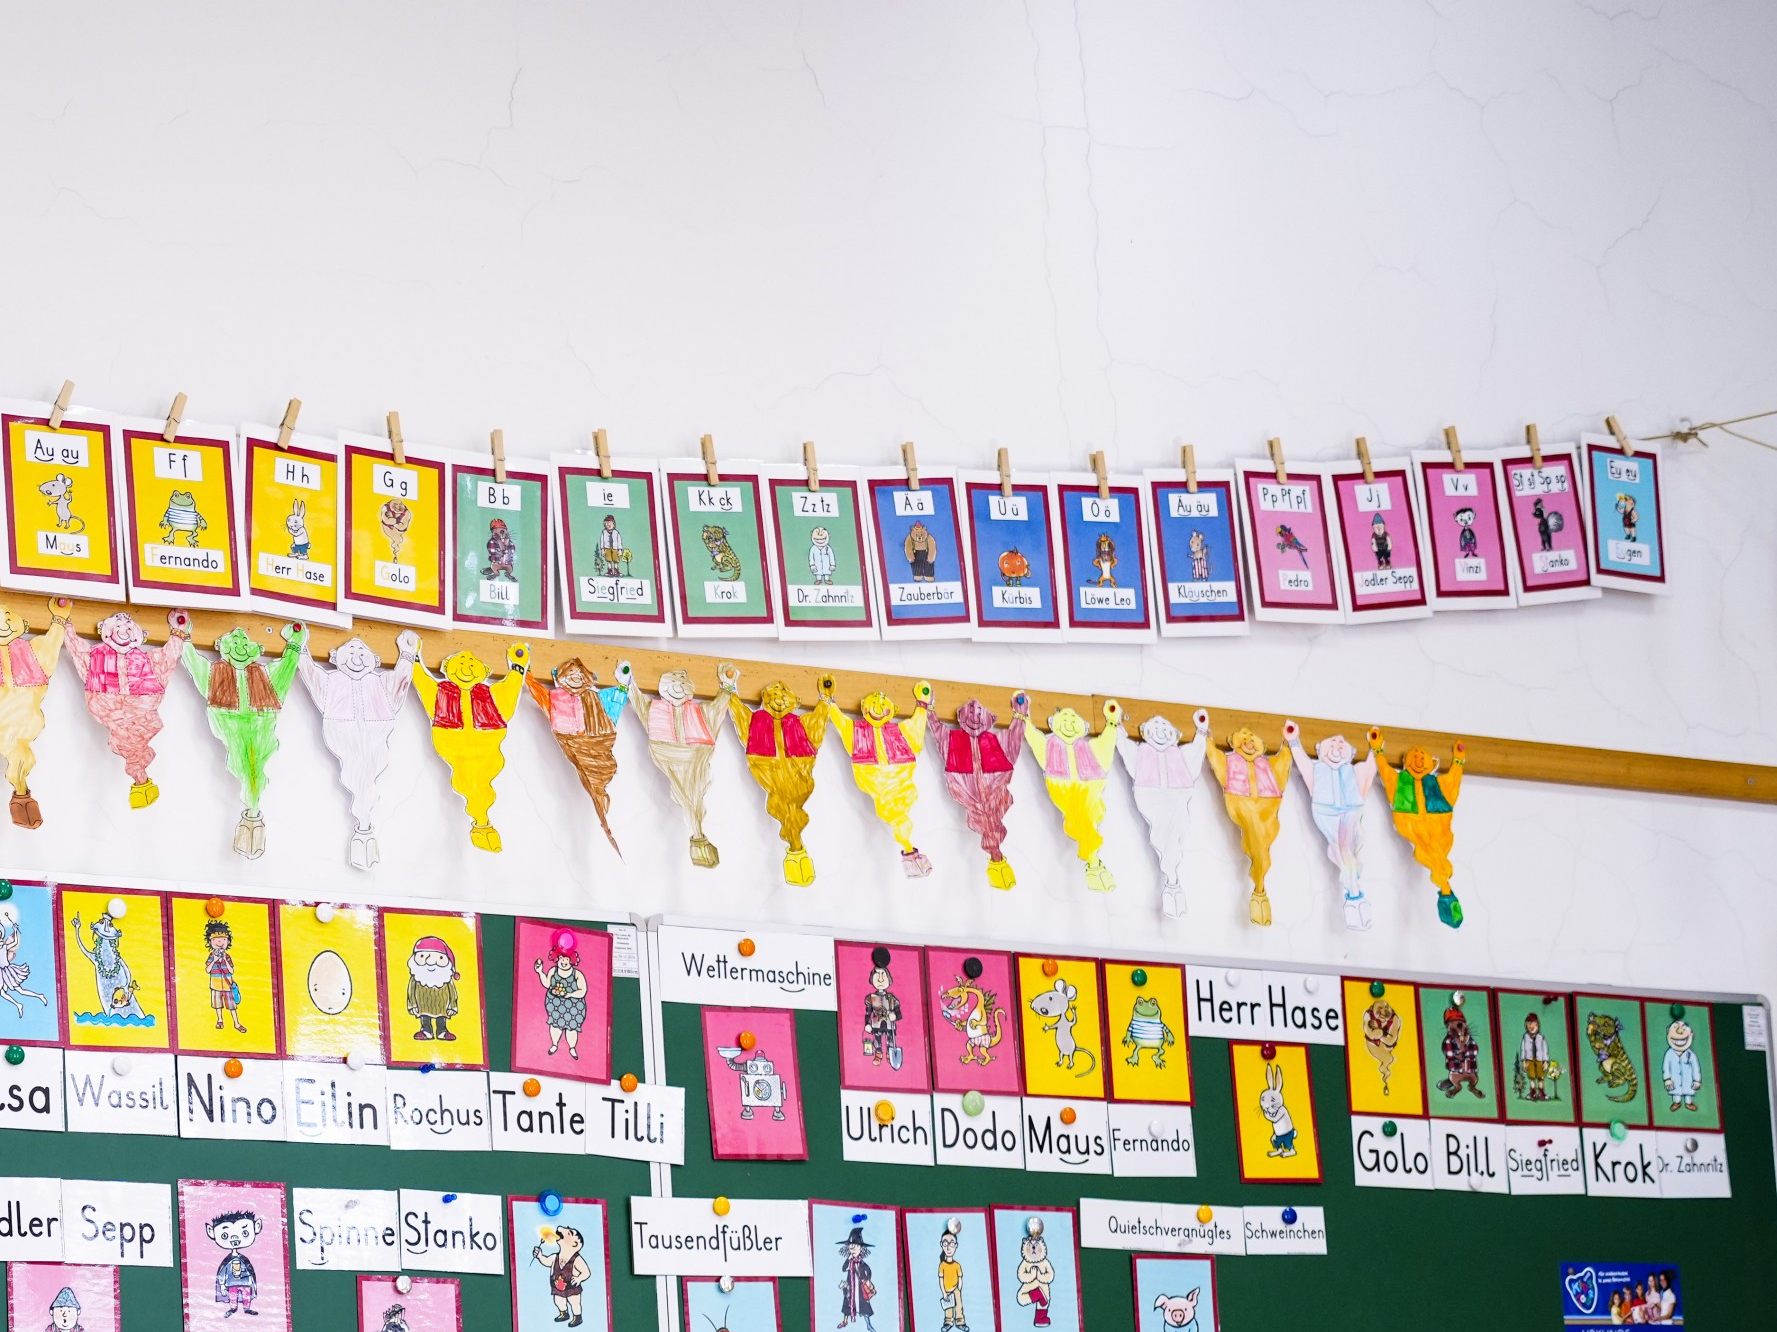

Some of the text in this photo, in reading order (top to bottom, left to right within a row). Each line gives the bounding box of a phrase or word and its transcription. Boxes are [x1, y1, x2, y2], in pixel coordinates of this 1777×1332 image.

[34, 439, 79, 460] Au au
[603, 489, 613, 502] ie
[151, 548, 218, 569] Fernando
[266, 560, 325, 582] Herr Hase
[381, 566, 410, 584] Golo
[489, 584, 510, 600] Bill
[588, 578, 644, 602] Siegfried
[714, 586, 738, 600] Krok
[797, 589, 811, 603] Dr.
[1391, 572, 1414, 588] Sepp
[1085, 593, 1131, 606] Löwe Leo
[682, 952, 832, 987] Wettermaschine
[1196, 979, 1339, 1031] Herr Hase
[71, 1073, 169, 1110] Wassil
[187, 1072, 277, 1124] Nino
[296, 1077, 377, 1130] Eilin
[394, 1093, 483, 1127] Rochus
[493, 1090, 664, 1144] Tante Tilli
[846, 1105, 927, 1146] Ulrich
[941, 1108, 1016, 1151] Dodo
[1028, 1114, 1105, 1156] Maus
[1112, 1129, 1190, 1152] Fernando
[1357, 1130, 1428, 1175] Golo
[1447, 1133, 1495, 1178] Bill
[1508, 1148, 1579, 1182] Siegfried
[1592, 1141, 1655, 1185] Krok
[81, 1204, 155, 1258] Sepp
[299, 1209, 497, 1261] Spinne Stanko
[634, 1222, 782, 1262] Tausendfüßler
[1246, 1222, 1324, 1240] Schweinchen
